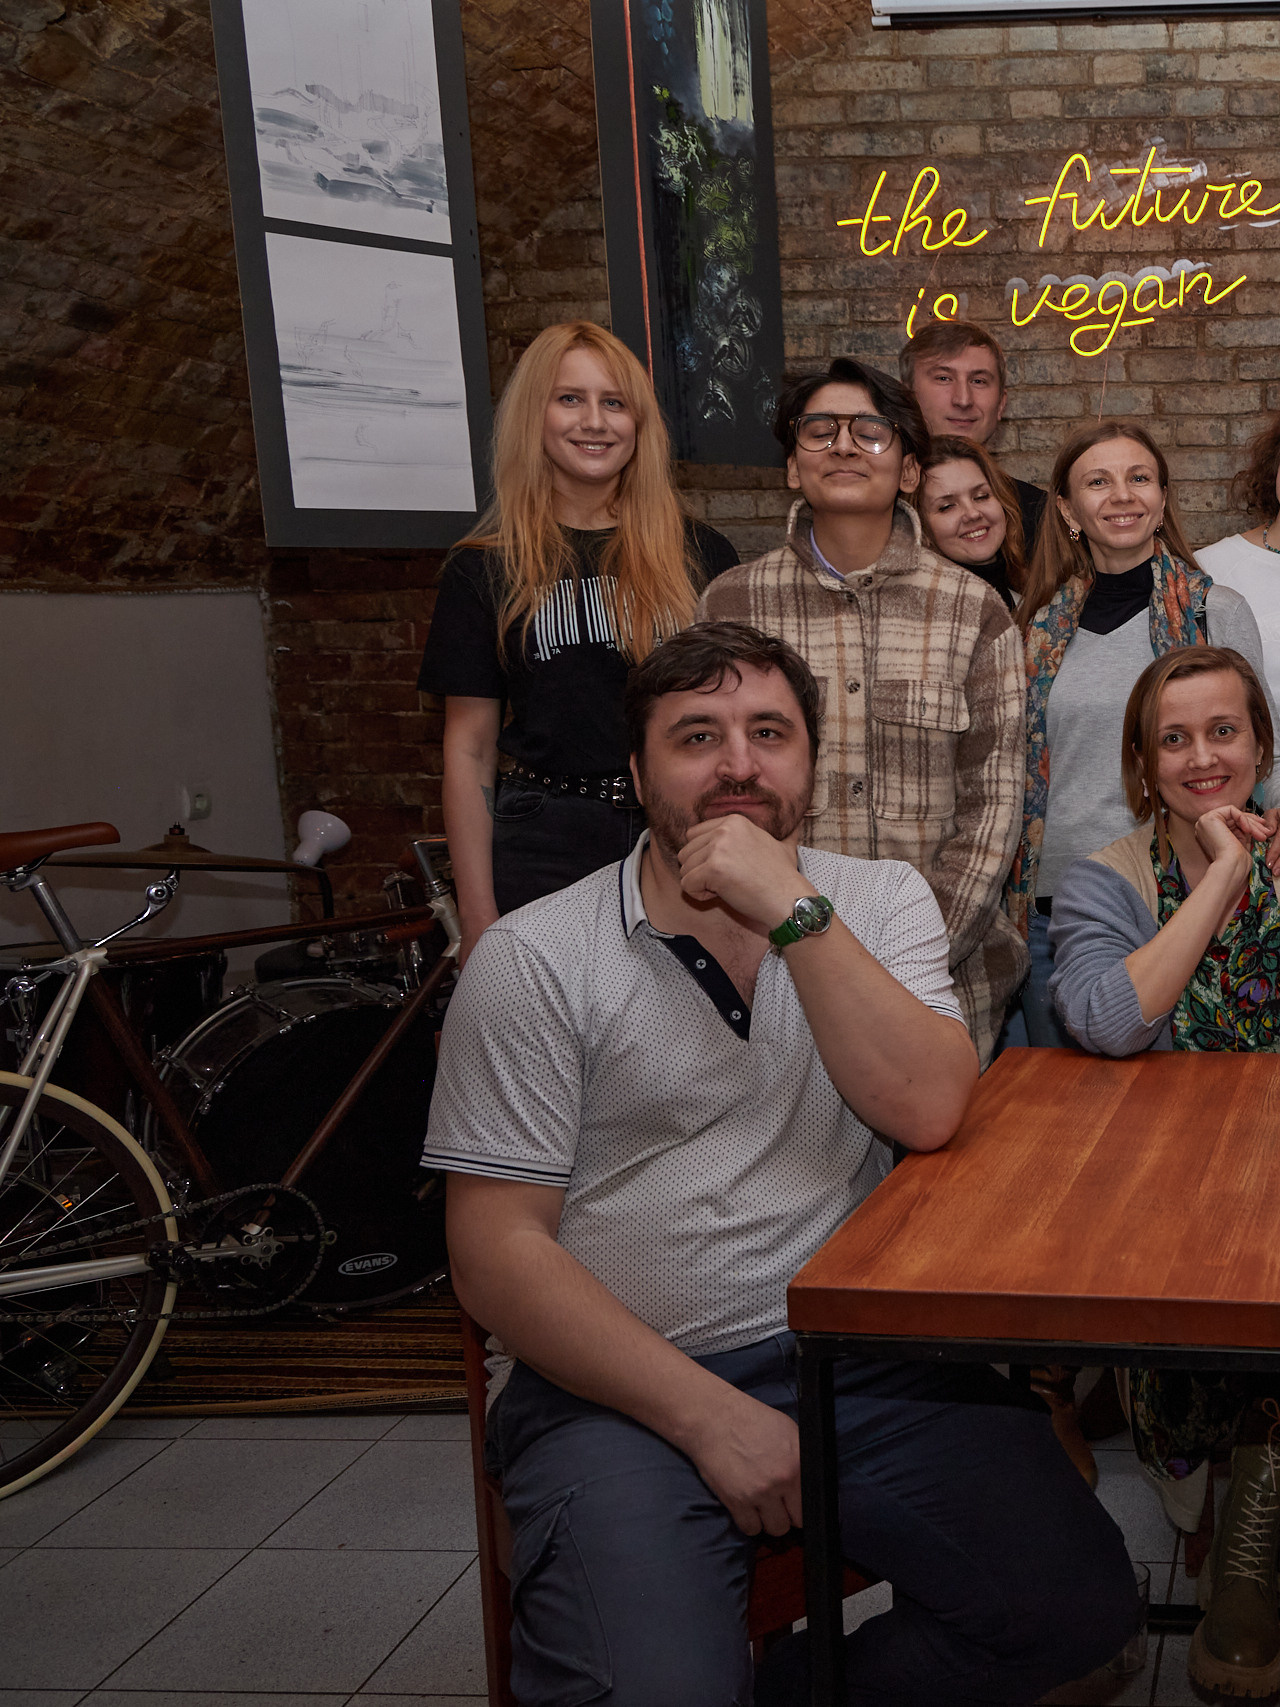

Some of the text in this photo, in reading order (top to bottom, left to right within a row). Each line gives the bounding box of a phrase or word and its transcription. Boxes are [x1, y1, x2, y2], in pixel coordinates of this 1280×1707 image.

[837, 165, 989, 257] the
[1010, 269, 1248, 358] vegan
[551, 647, 562, 655] 7A
[345, 1256, 390, 1271] EVANS
